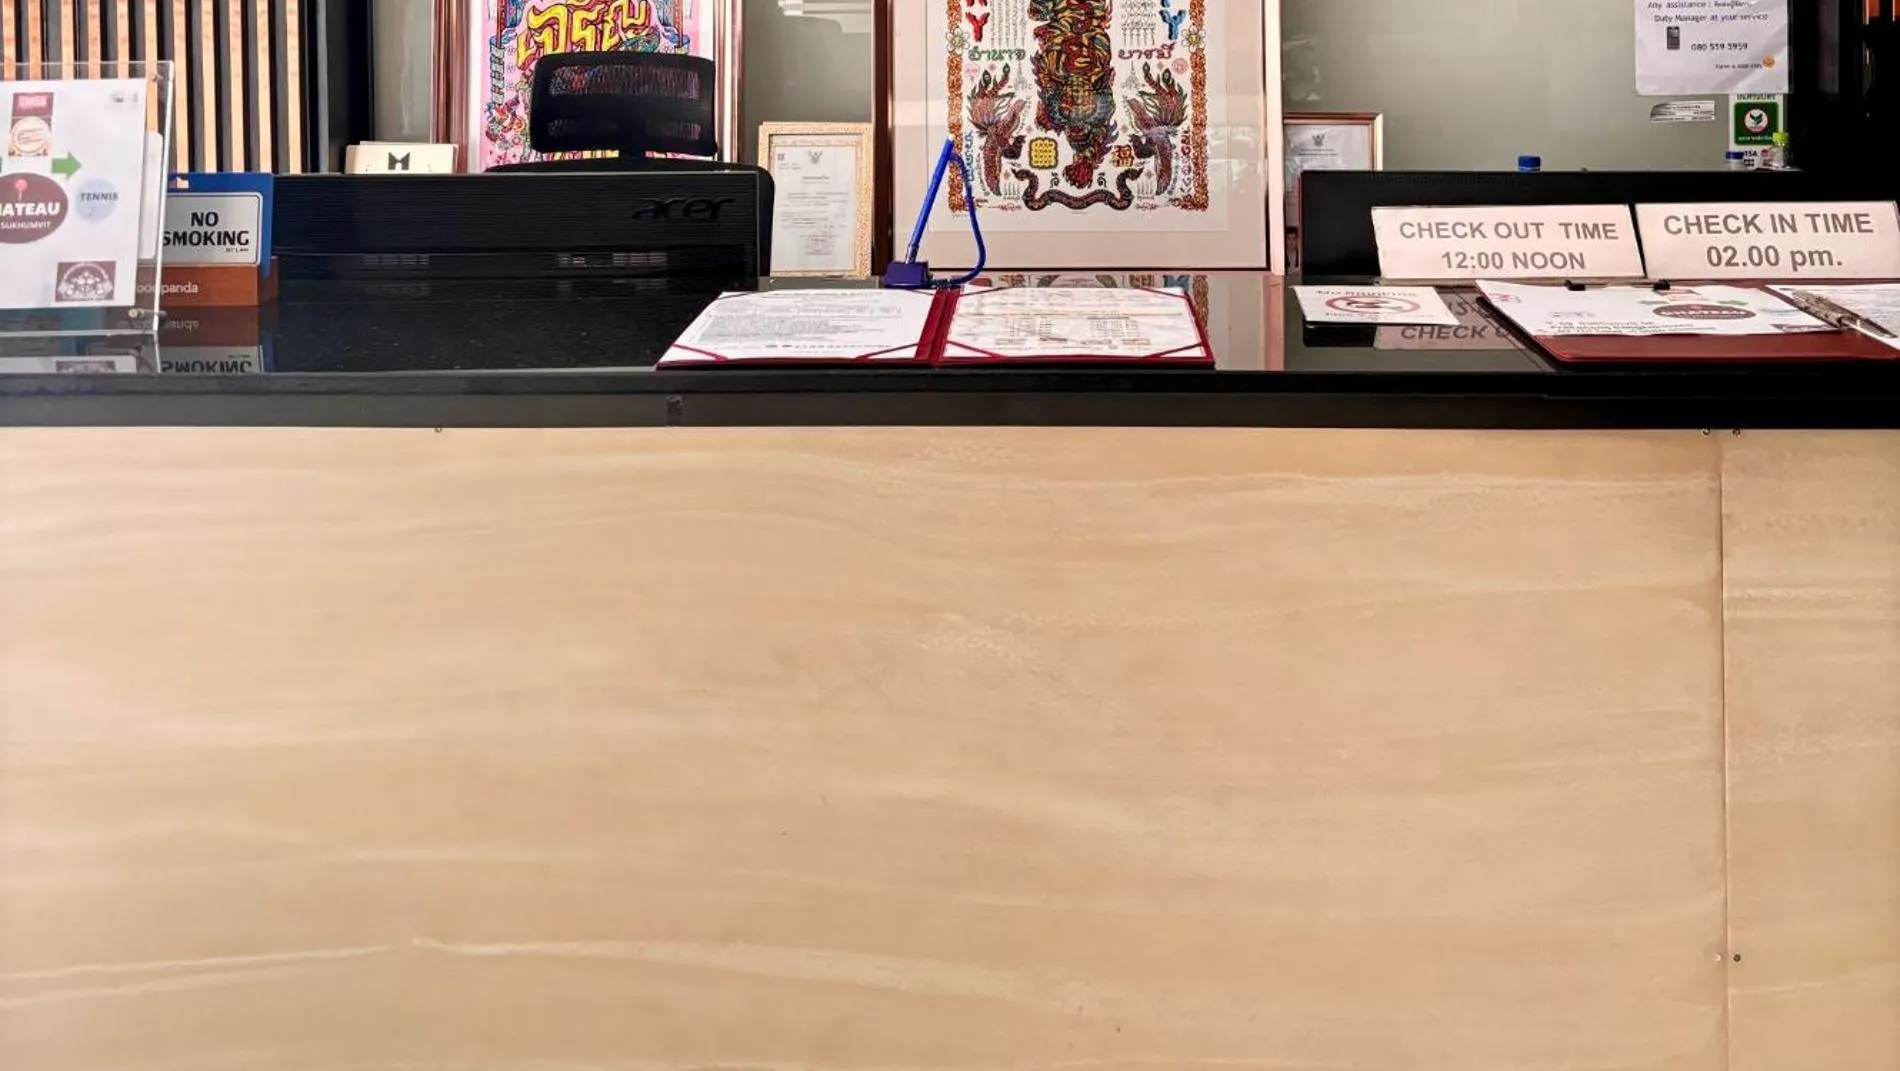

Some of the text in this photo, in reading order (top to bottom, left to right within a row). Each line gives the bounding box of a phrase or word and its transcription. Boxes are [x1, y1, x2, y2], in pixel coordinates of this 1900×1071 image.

[1666, 0, 1706, 9] assistance
[1654, 14, 1672, 23] Duty
[1675, 14, 1707, 23] Manager
[1721, 15, 1738, 23] your
[80, 192, 118, 202] TENNIS
[632, 196, 735, 221] acer
[191, 211, 219, 227] NO
[1664, 213, 1874, 235] CHECK IN TIME
[162, 230, 250, 247] SMOKING
[1399, 221, 1619, 240] CHECK OUT TIME
[1441, 251, 1586, 270] 12:00 NOON
[1706, 245, 1843, 272] 02.00 pm.
